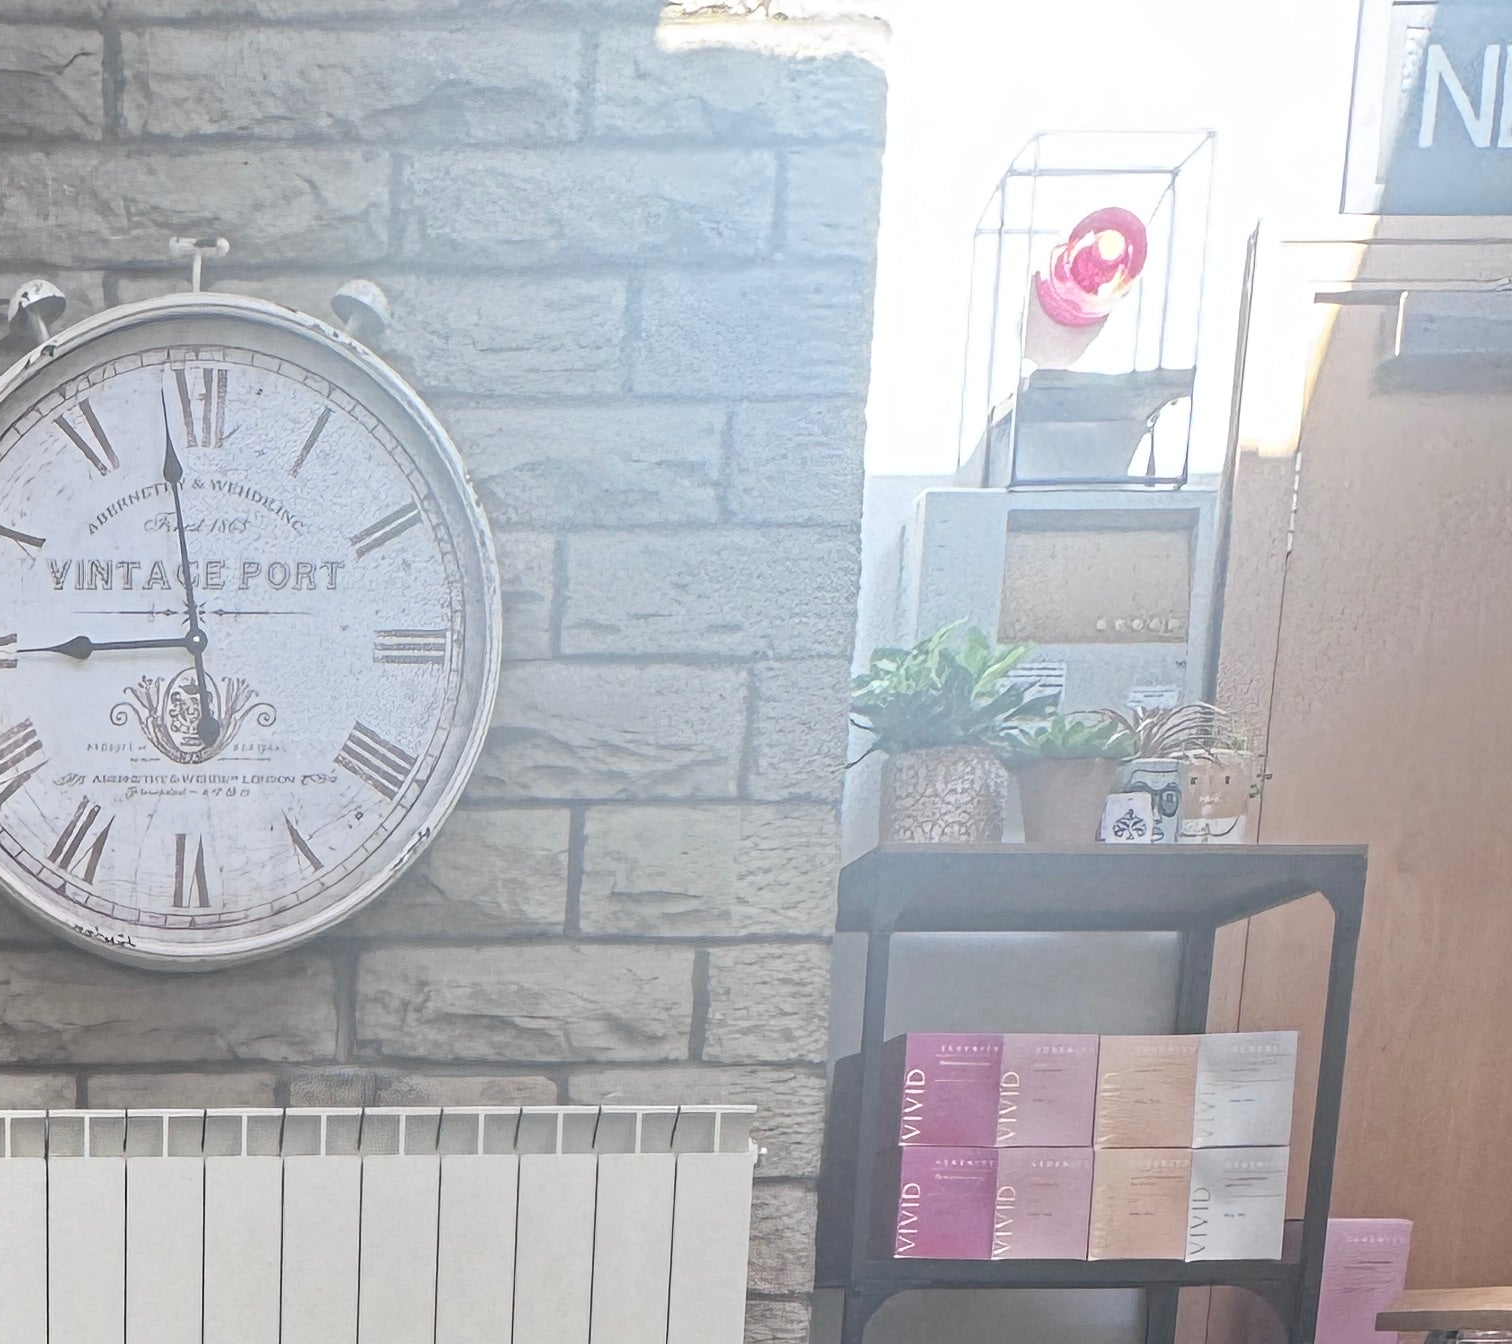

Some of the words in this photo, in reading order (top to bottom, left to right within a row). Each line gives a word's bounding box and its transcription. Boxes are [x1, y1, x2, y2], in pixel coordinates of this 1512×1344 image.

[47, 559, 226, 591] VINTAGE
[238, 560, 345, 591] PORT
[373, 628, 446, 665] III
[901, 1068, 926, 1140] VIVID
[996, 1071, 1020, 1141] VIVID
[897, 1182, 922, 1253] VIVID
[992, 1185, 1017, 1254] VIVID
[1189, 1187, 1212, 1255] VIVID
